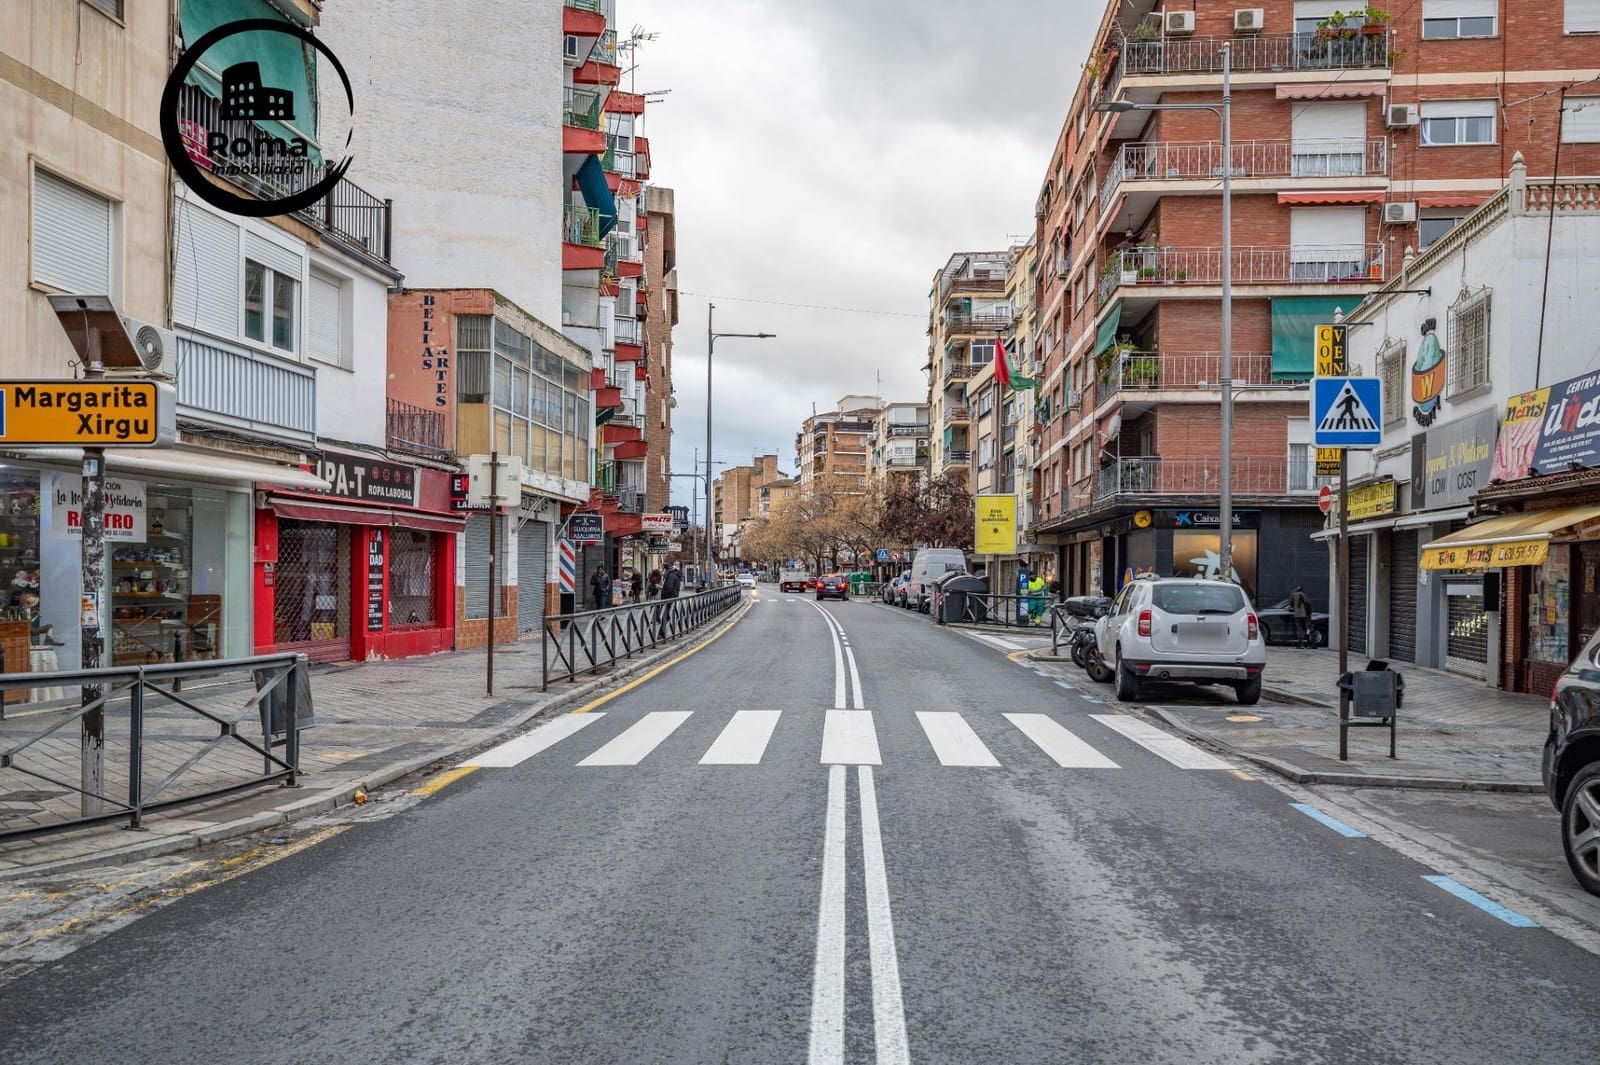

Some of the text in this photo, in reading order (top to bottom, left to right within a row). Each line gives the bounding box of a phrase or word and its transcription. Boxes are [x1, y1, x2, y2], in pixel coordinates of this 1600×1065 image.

[1320, 328, 1331, 376] COM
[1333, 329, 1345, 376] VEN
[14, 386, 148, 412] Margarita
[76, 413, 149, 439] Xirgu
[368, 484, 413, 500] ROPA LABORAL
[1457, 470, 1477, 490] COST
[369, 554, 384, 566] DAD
